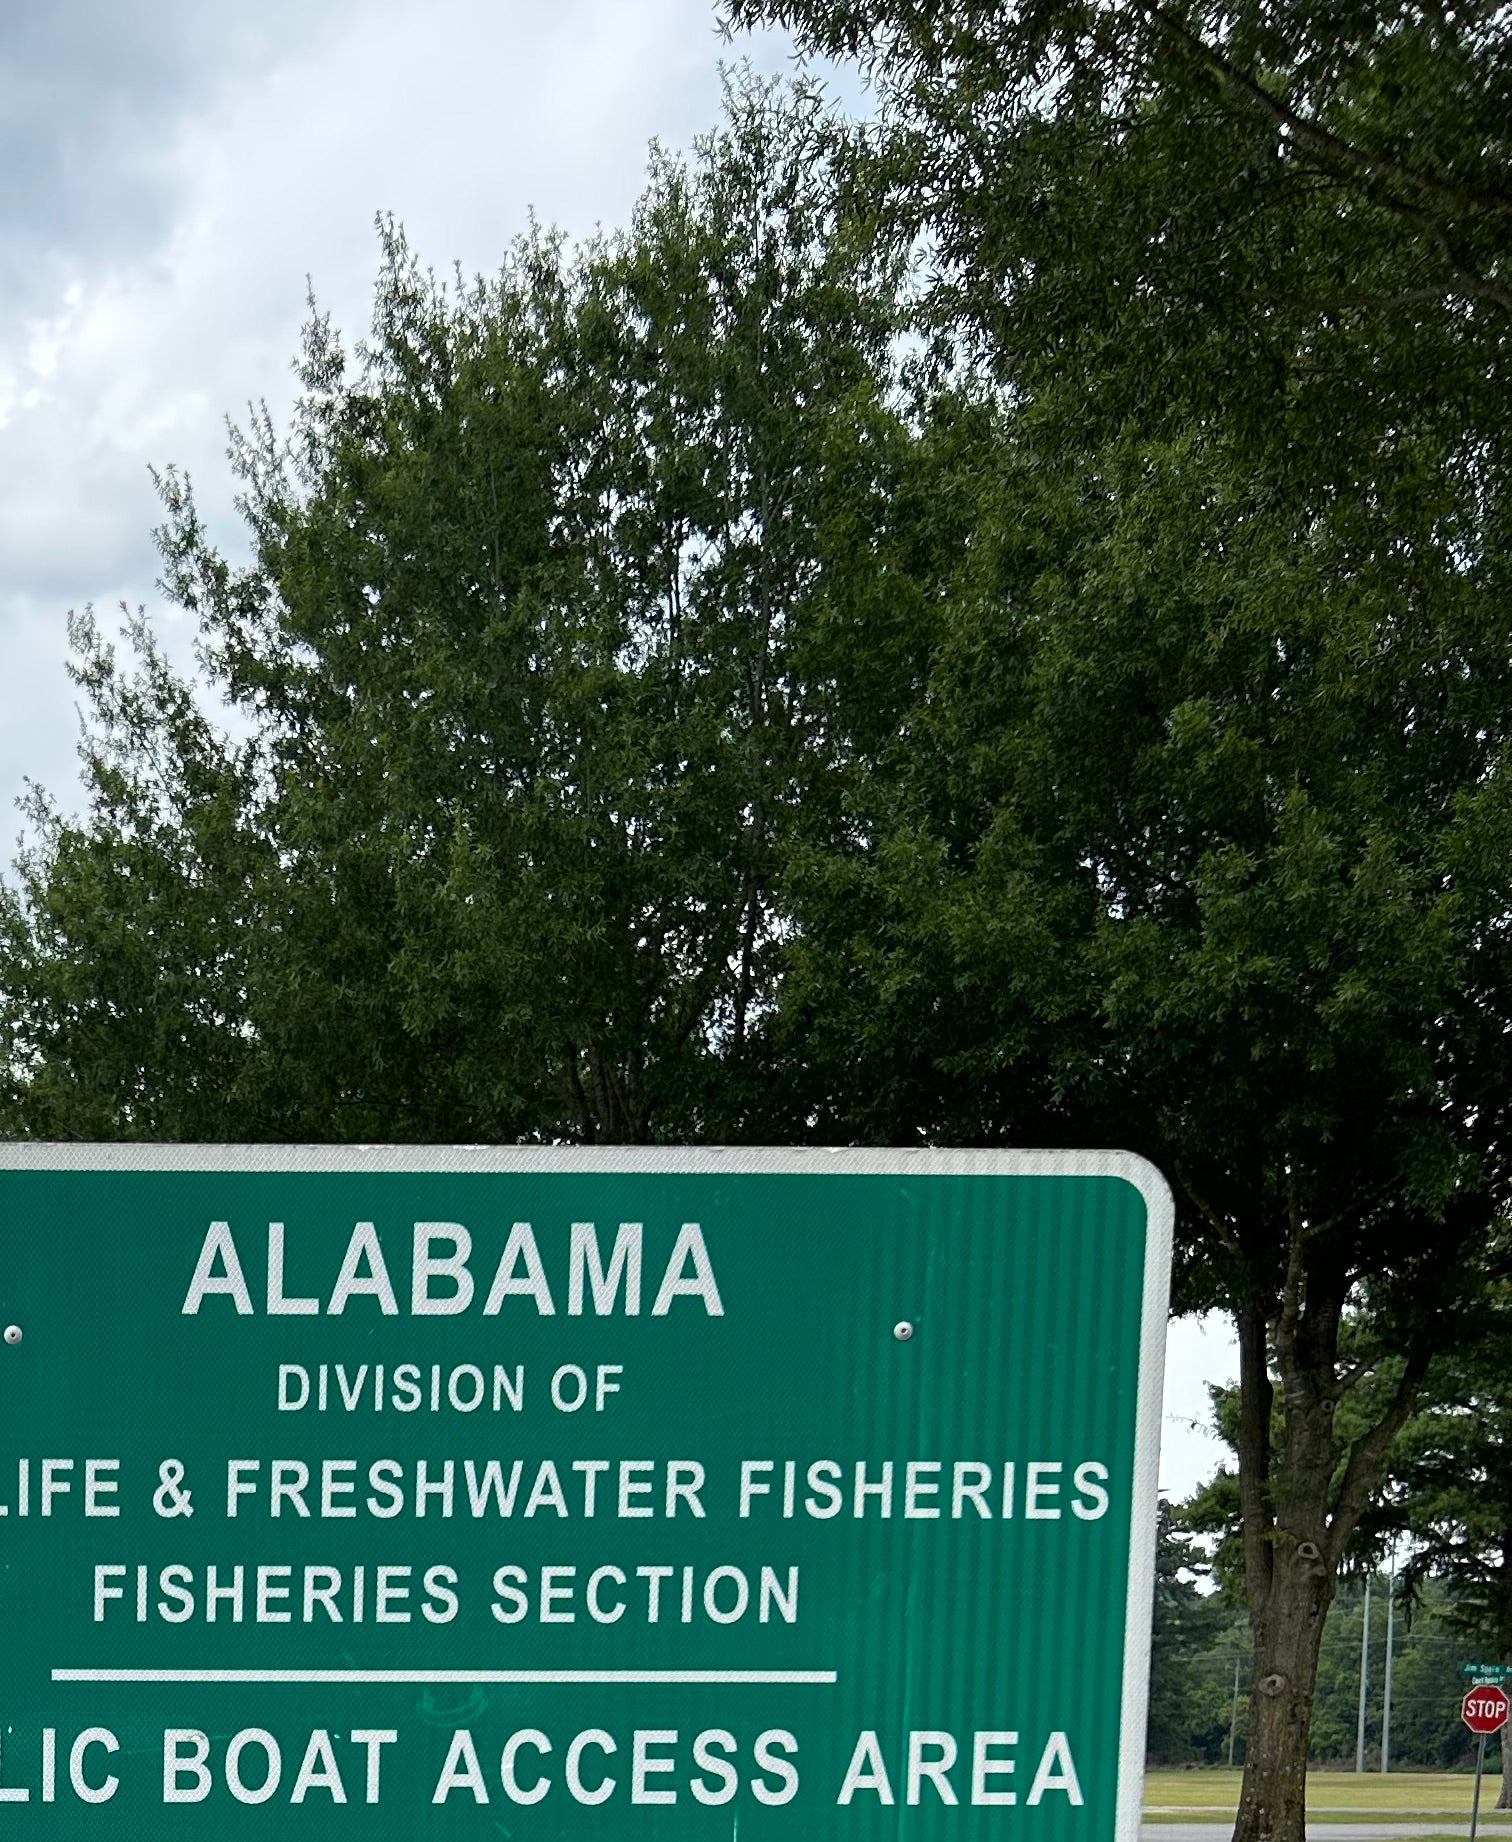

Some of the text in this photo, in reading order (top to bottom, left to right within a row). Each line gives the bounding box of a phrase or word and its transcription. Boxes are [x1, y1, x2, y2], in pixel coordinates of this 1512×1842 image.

[182, 1221, 725, 1316] ALABAMA
[278, 1364, 623, 1412] DIVISION OF
[153, 1459, 194, 1518] &
[227, 1459, 706, 1518] FRESHWATER
[739, 1460, 1109, 1520] FISHERIES
[94, 1564, 799, 1624] FISHERIES SECTION
[1465, 1699, 1506, 1719] STOP
[163, 1728, 397, 1804] BOAT
[432, 1729, 799, 1806] ACCESS
[837, 1730, 1084, 1806] AREA
